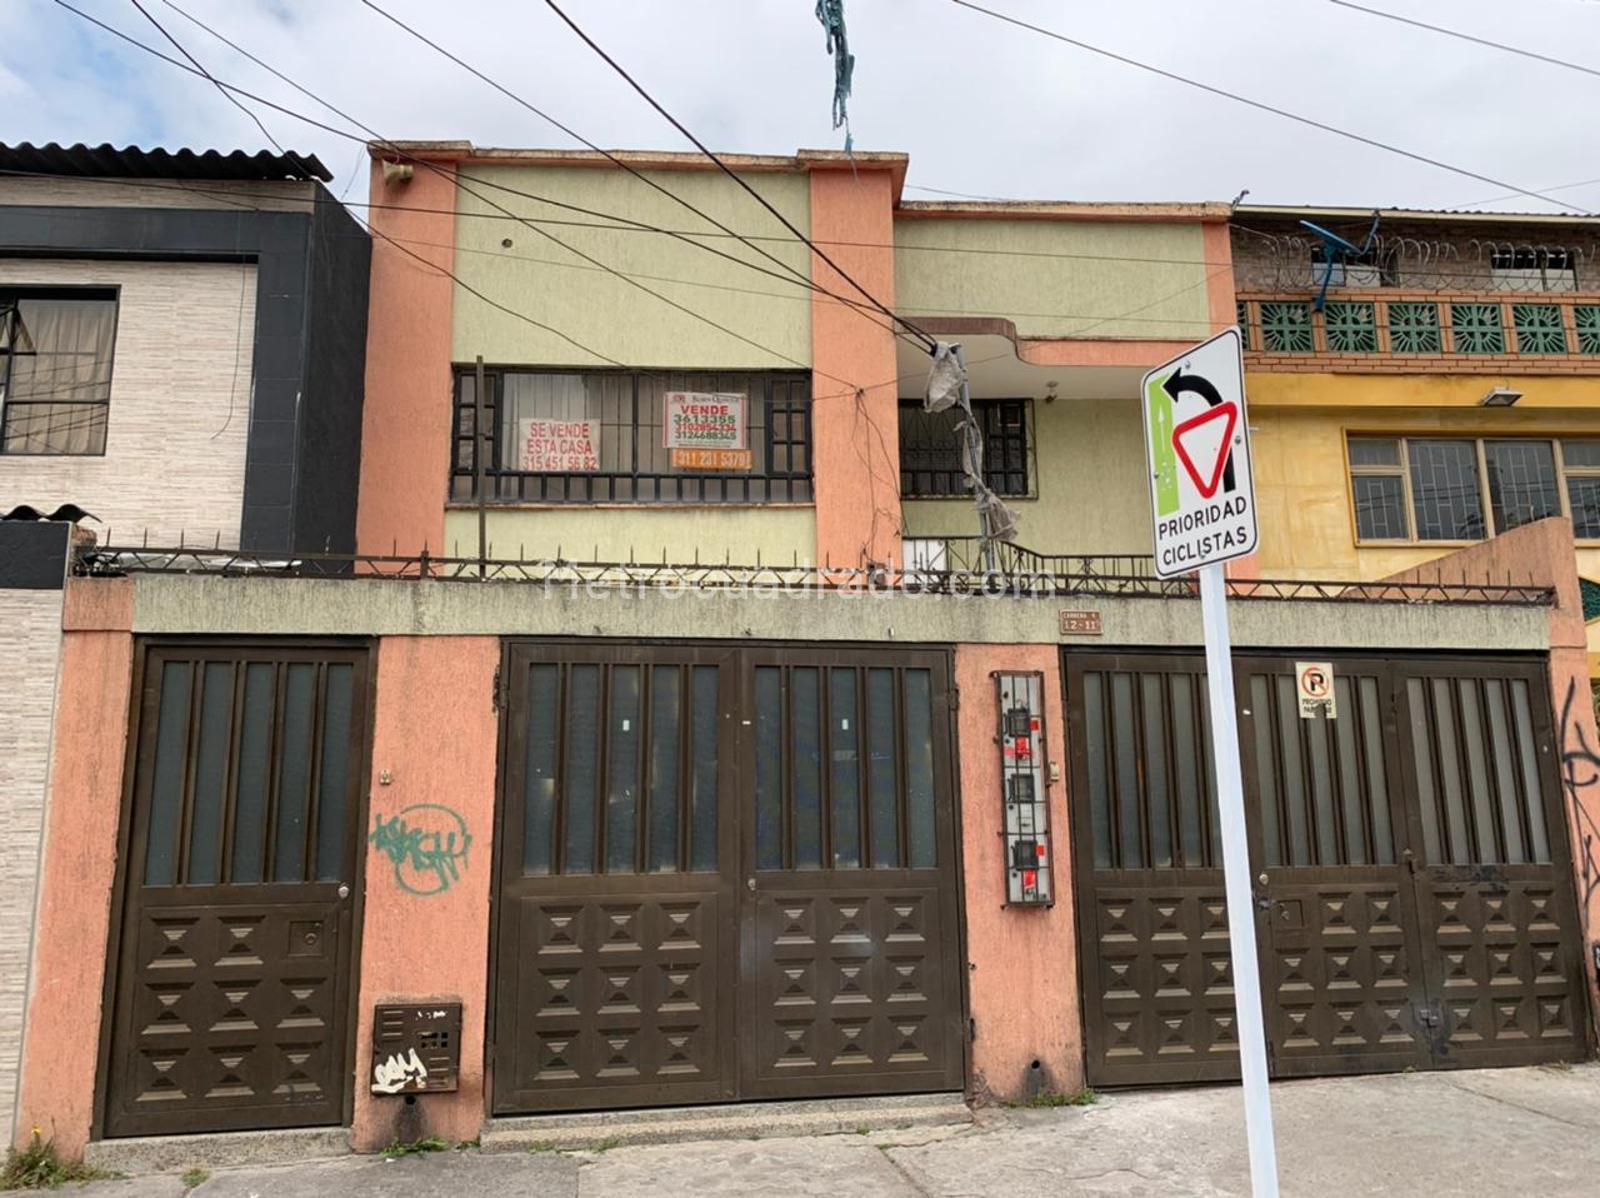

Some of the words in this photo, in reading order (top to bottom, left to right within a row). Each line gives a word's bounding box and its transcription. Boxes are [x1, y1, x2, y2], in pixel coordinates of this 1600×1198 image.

[680, 404, 729, 415] VENDE
[673, 414, 736, 424] 3613355
[530, 422, 546, 438] SE
[549, 423, 589, 438] VENDE
[527, 439, 557, 454] ESTA
[560, 440, 593, 455] CASA
[522, 455, 543, 470] 315
[545, 456, 564, 470] 451
[583, 456, 597, 471] 82
[1158, 495, 1247, 540] PRIORIDAD
[1163, 526, 1248, 566] CICLISTAS
